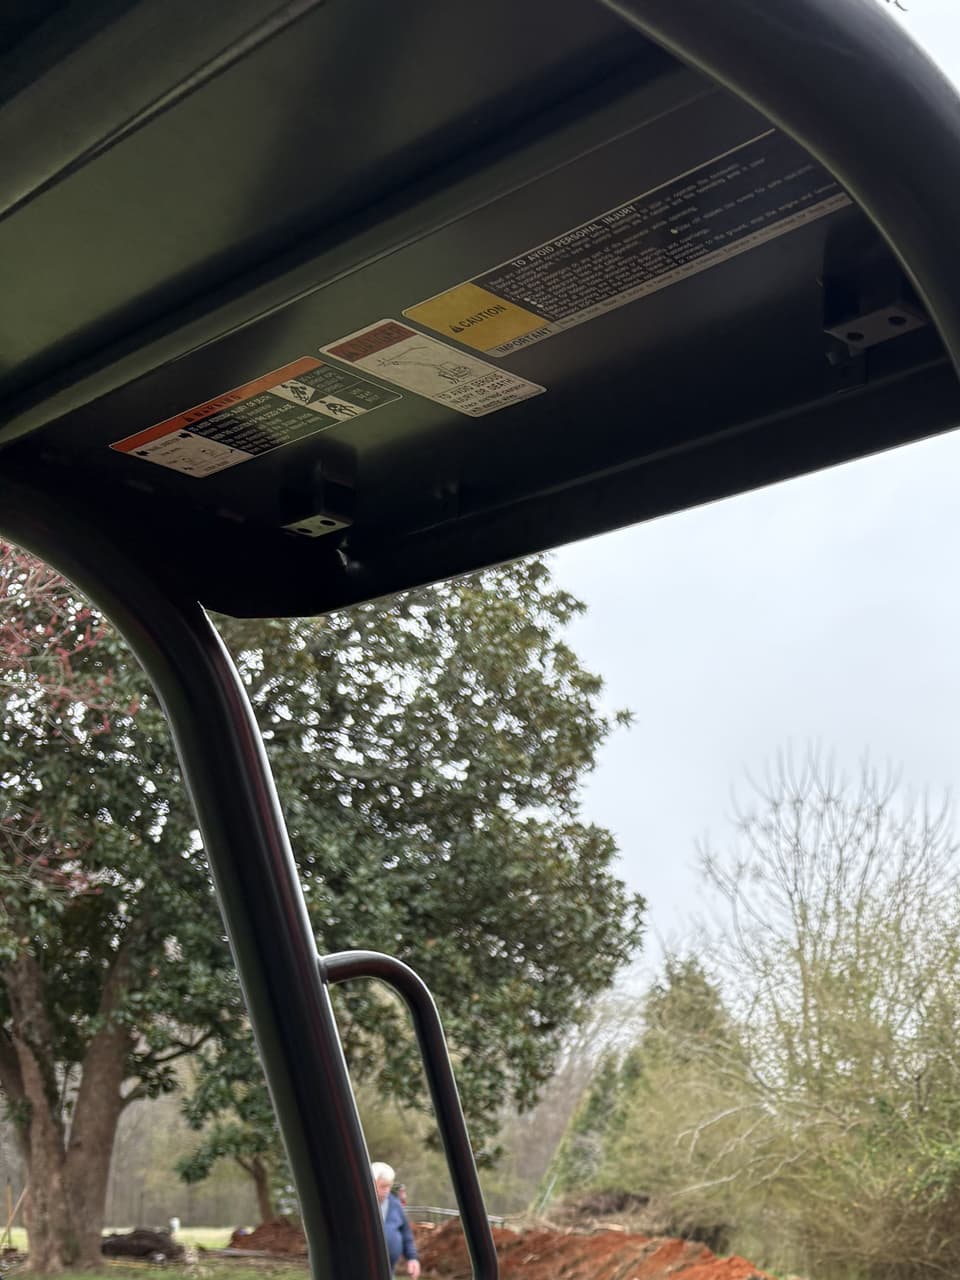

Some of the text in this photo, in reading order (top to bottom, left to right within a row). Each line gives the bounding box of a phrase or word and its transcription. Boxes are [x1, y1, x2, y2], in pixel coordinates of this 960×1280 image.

[511, 204, 637, 269] TO AVOID PERSONAL INJURY
[459, 304, 507, 330] CAUTION
[495, 327, 553, 354] IMPORTANT
